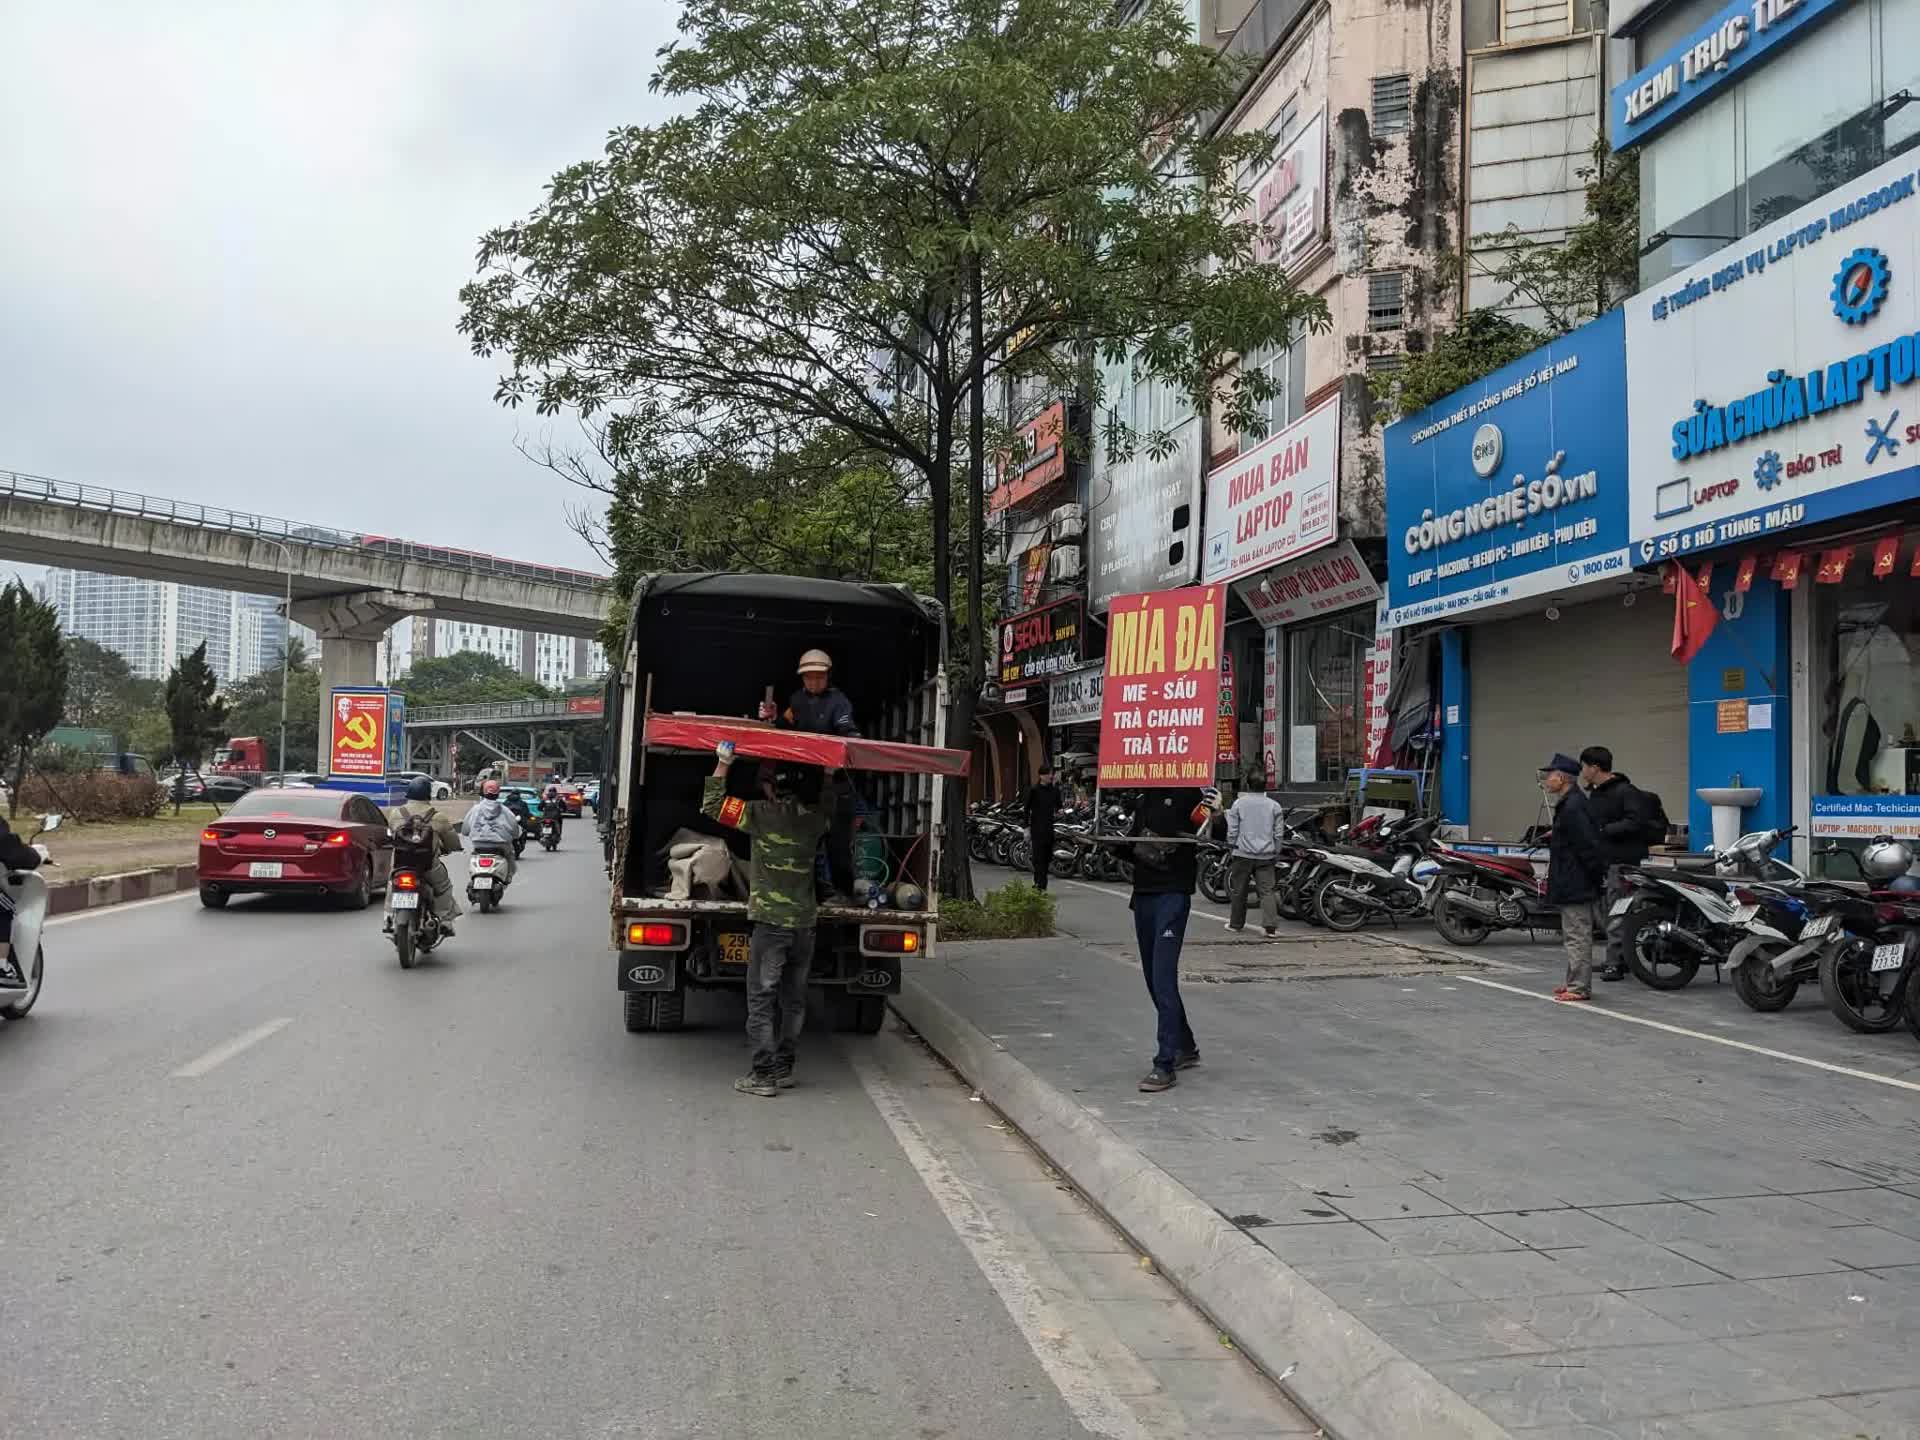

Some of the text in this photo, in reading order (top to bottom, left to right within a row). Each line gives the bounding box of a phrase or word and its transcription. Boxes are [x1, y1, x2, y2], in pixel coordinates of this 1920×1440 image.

[1624, 63, 1679, 124] XEM
[1680, 15, 1750, 82] TRỰC
[1745, 249, 1766, 274] VỤ
[1767, 218, 1827, 264] LAPTOP
[1829, 173, 1915, 233] MACBOOK
[1556, 355, 1578, 375] NAM
[1671, 399, 1727, 463] SỬA
[1228, 436, 1309, 509] MUA BÁN
[1694, 479, 1739, 505] LAPTOP
[1236, 490, 1293, 544] LAPTOP
[1404, 508, 1465, 556] CÔNG
[1464, 473, 1527, 536] NGHỆ
[1660, 531, 1679, 555] SỐ
[1695, 525, 1715, 546] HỒ
[1719, 516, 1761, 540] TÙNG
[1765, 503, 1805, 529] MẬU
[1583, 559, 1602, 577] 1800
[1014, 614, 1051, 652] SEOUL
[1109, 588, 1216, 677] MÍA ĐÁ
[1122, 683, 1147, 703] ME
[1163, 674, 1197, 700] SẤU
[1375, 683, 1388, 697] TOP
[1113, 707, 1142, 729] TRÀ
[1147, 707, 1204, 727] CHANH
[1122, 733, 1152, 756] TRÀ
[1158, 729, 1189, 754] TẮC
[1815, 803, 1920, 813] Certified Mac Techician
[1814, 823, 1840, 833] LAPTOP
[634, 969, 658, 980] KIA
